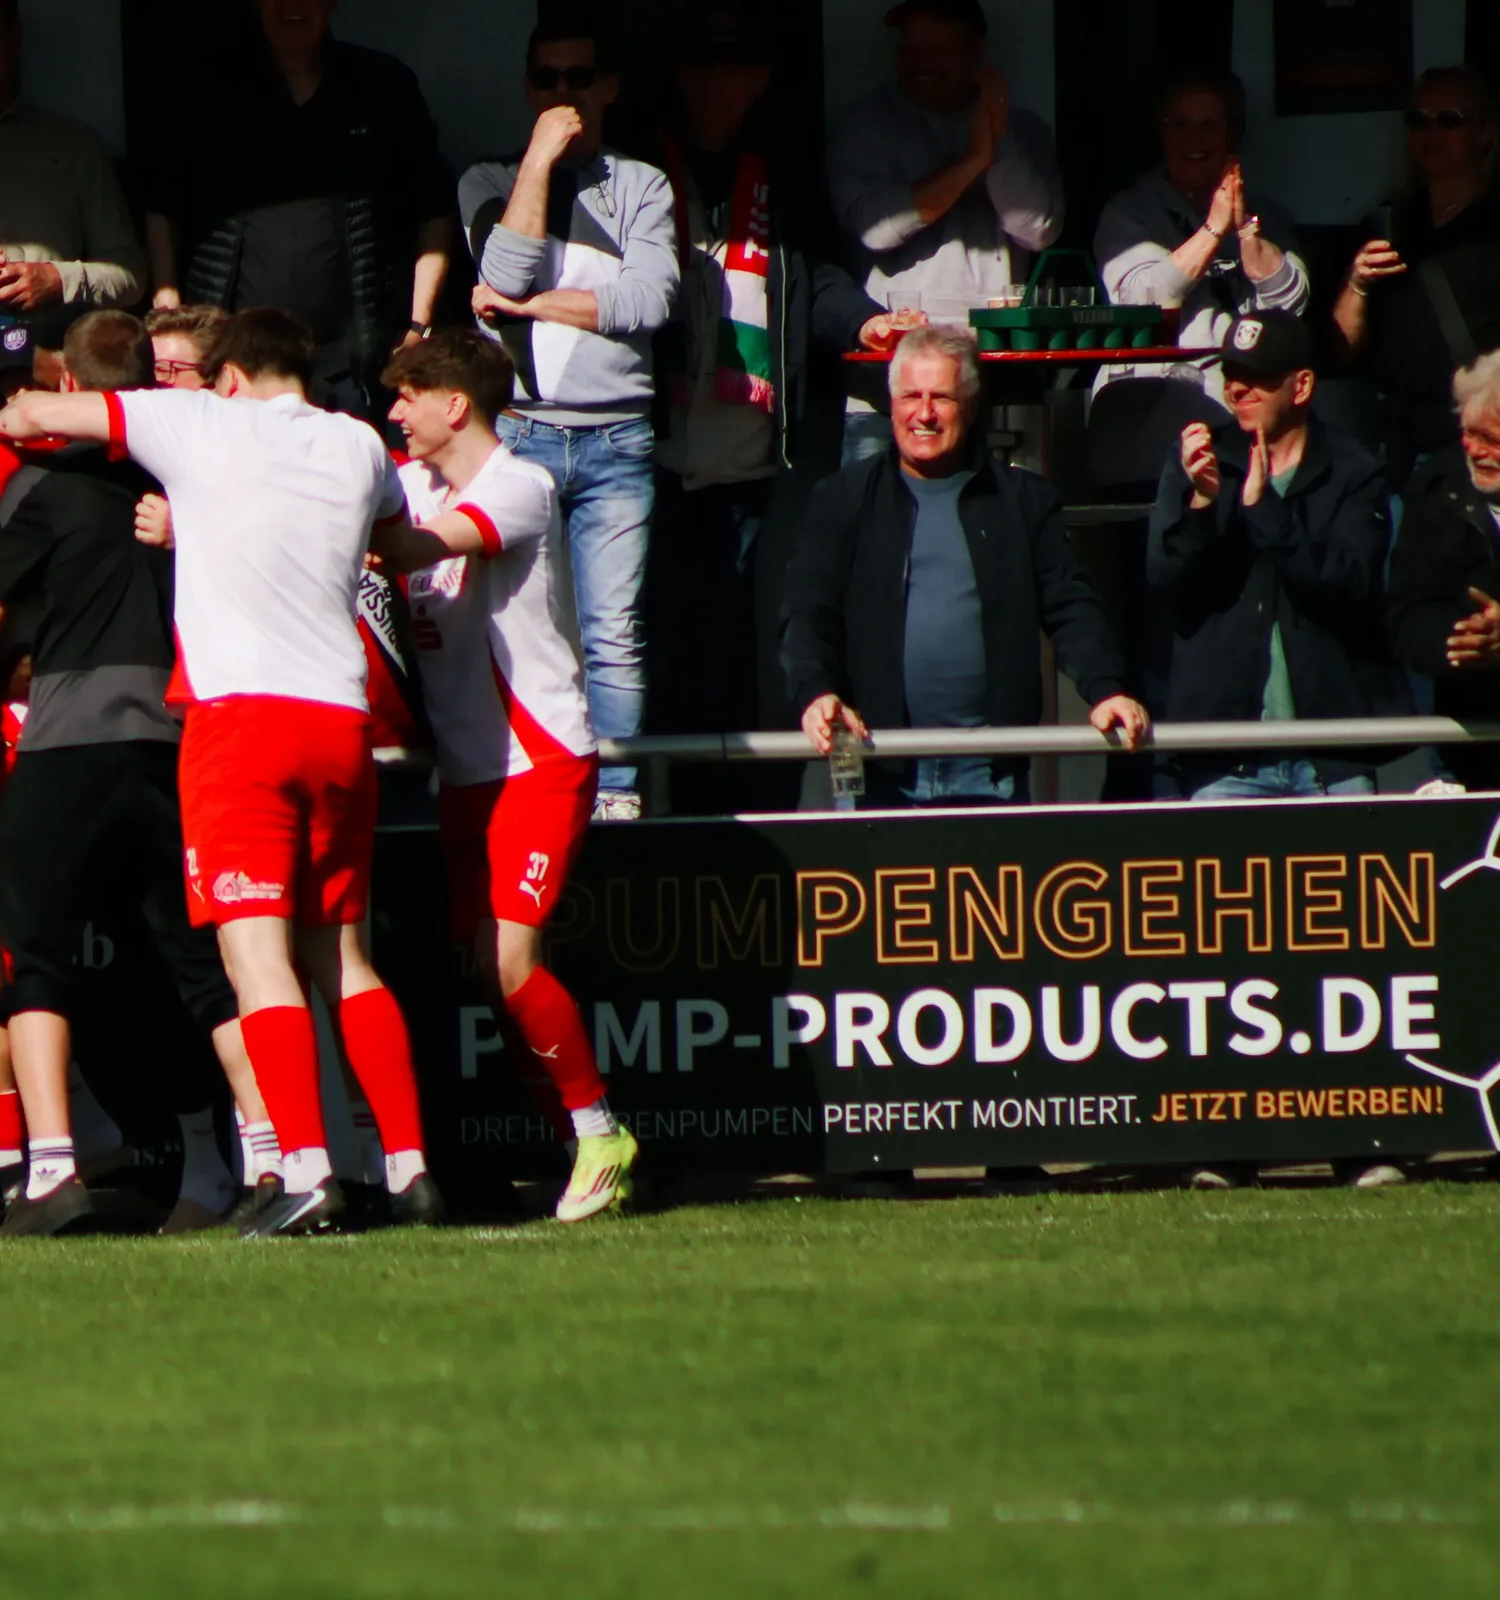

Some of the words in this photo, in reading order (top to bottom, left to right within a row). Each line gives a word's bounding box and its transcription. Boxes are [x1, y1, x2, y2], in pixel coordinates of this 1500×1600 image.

[526, 852, 549, 882] 37
[455, 852, 1436, 976] PUMPENGEHEN
[459, 975, 1441, 1079] PMP-PRODUCTS.DE
[461, 1106, 814, 1146] DREHBENPUMPEN
[824, 1101, 962, 1133] PERFEKT
[973, 1095, 1141, 1129] MONTIERT.
[1152, 1092, 1247, 1122] JETZT
[1256, 1086, 1444, 1118] BEWERBEN!
